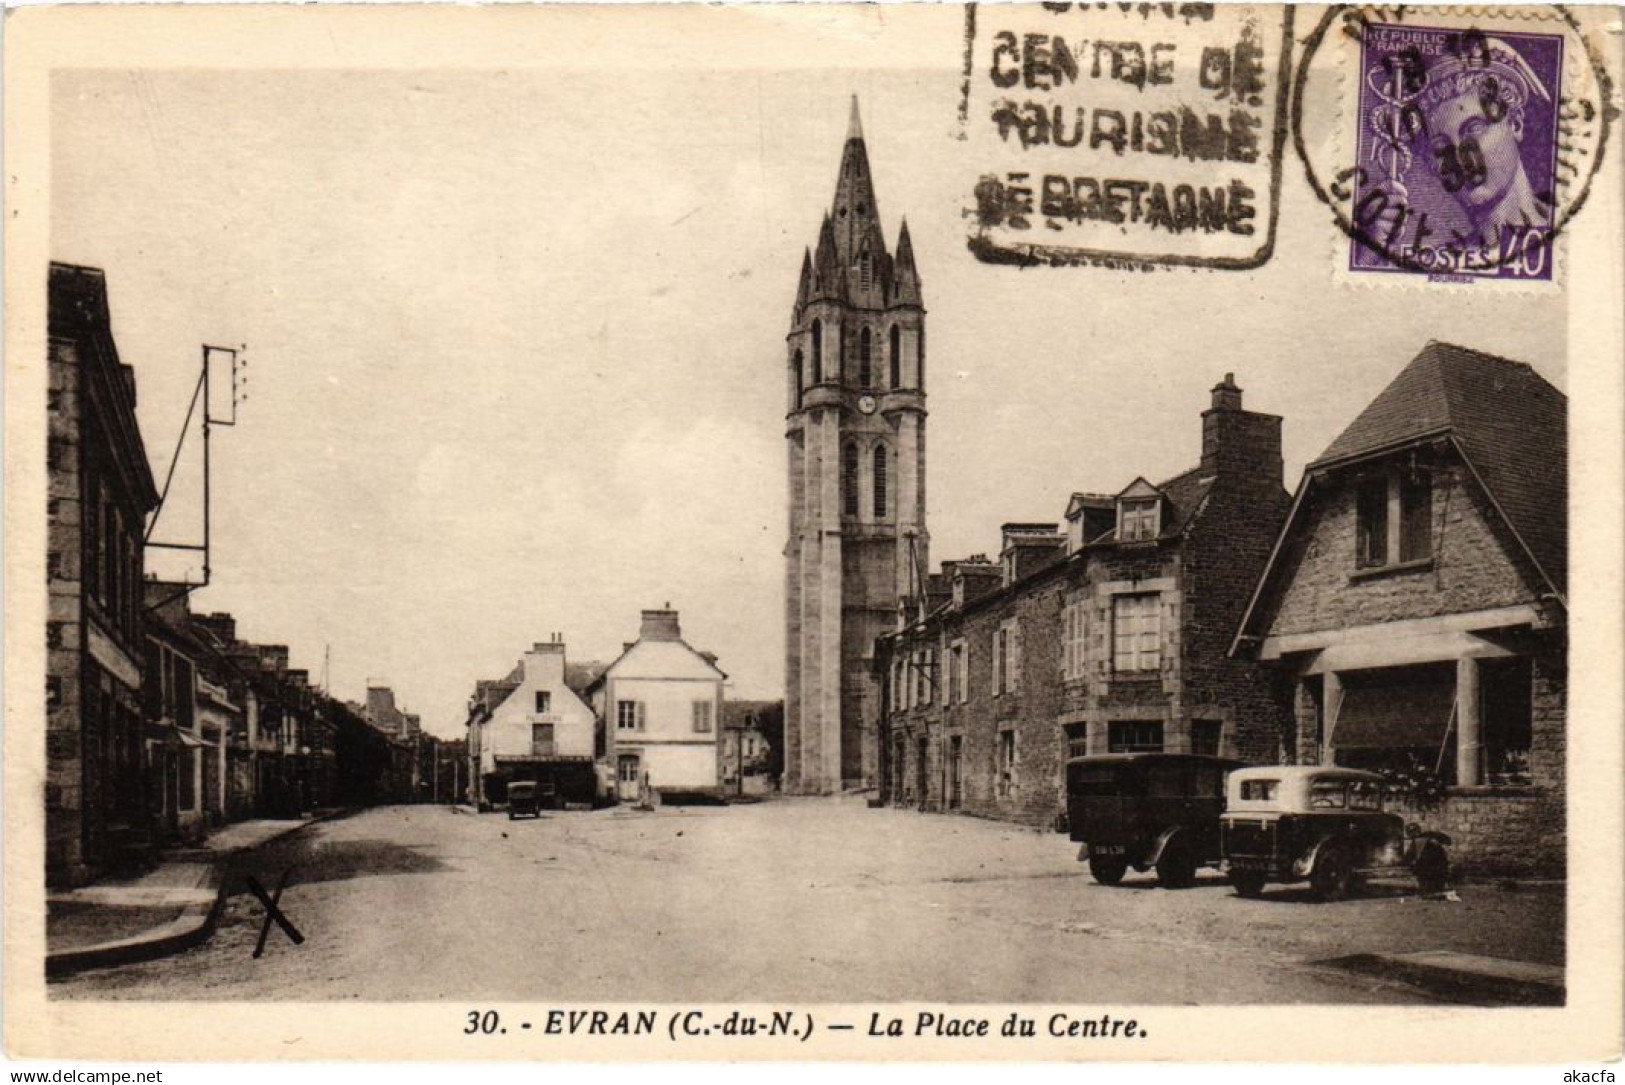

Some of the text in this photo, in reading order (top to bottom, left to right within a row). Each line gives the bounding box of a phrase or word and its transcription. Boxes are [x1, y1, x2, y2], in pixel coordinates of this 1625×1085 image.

[991, 98, 1262, 163] TOURISME
[1040, 174, 1257, 236] BRETAGNE
[1400, 229, 1545, 277] POSTES 40
